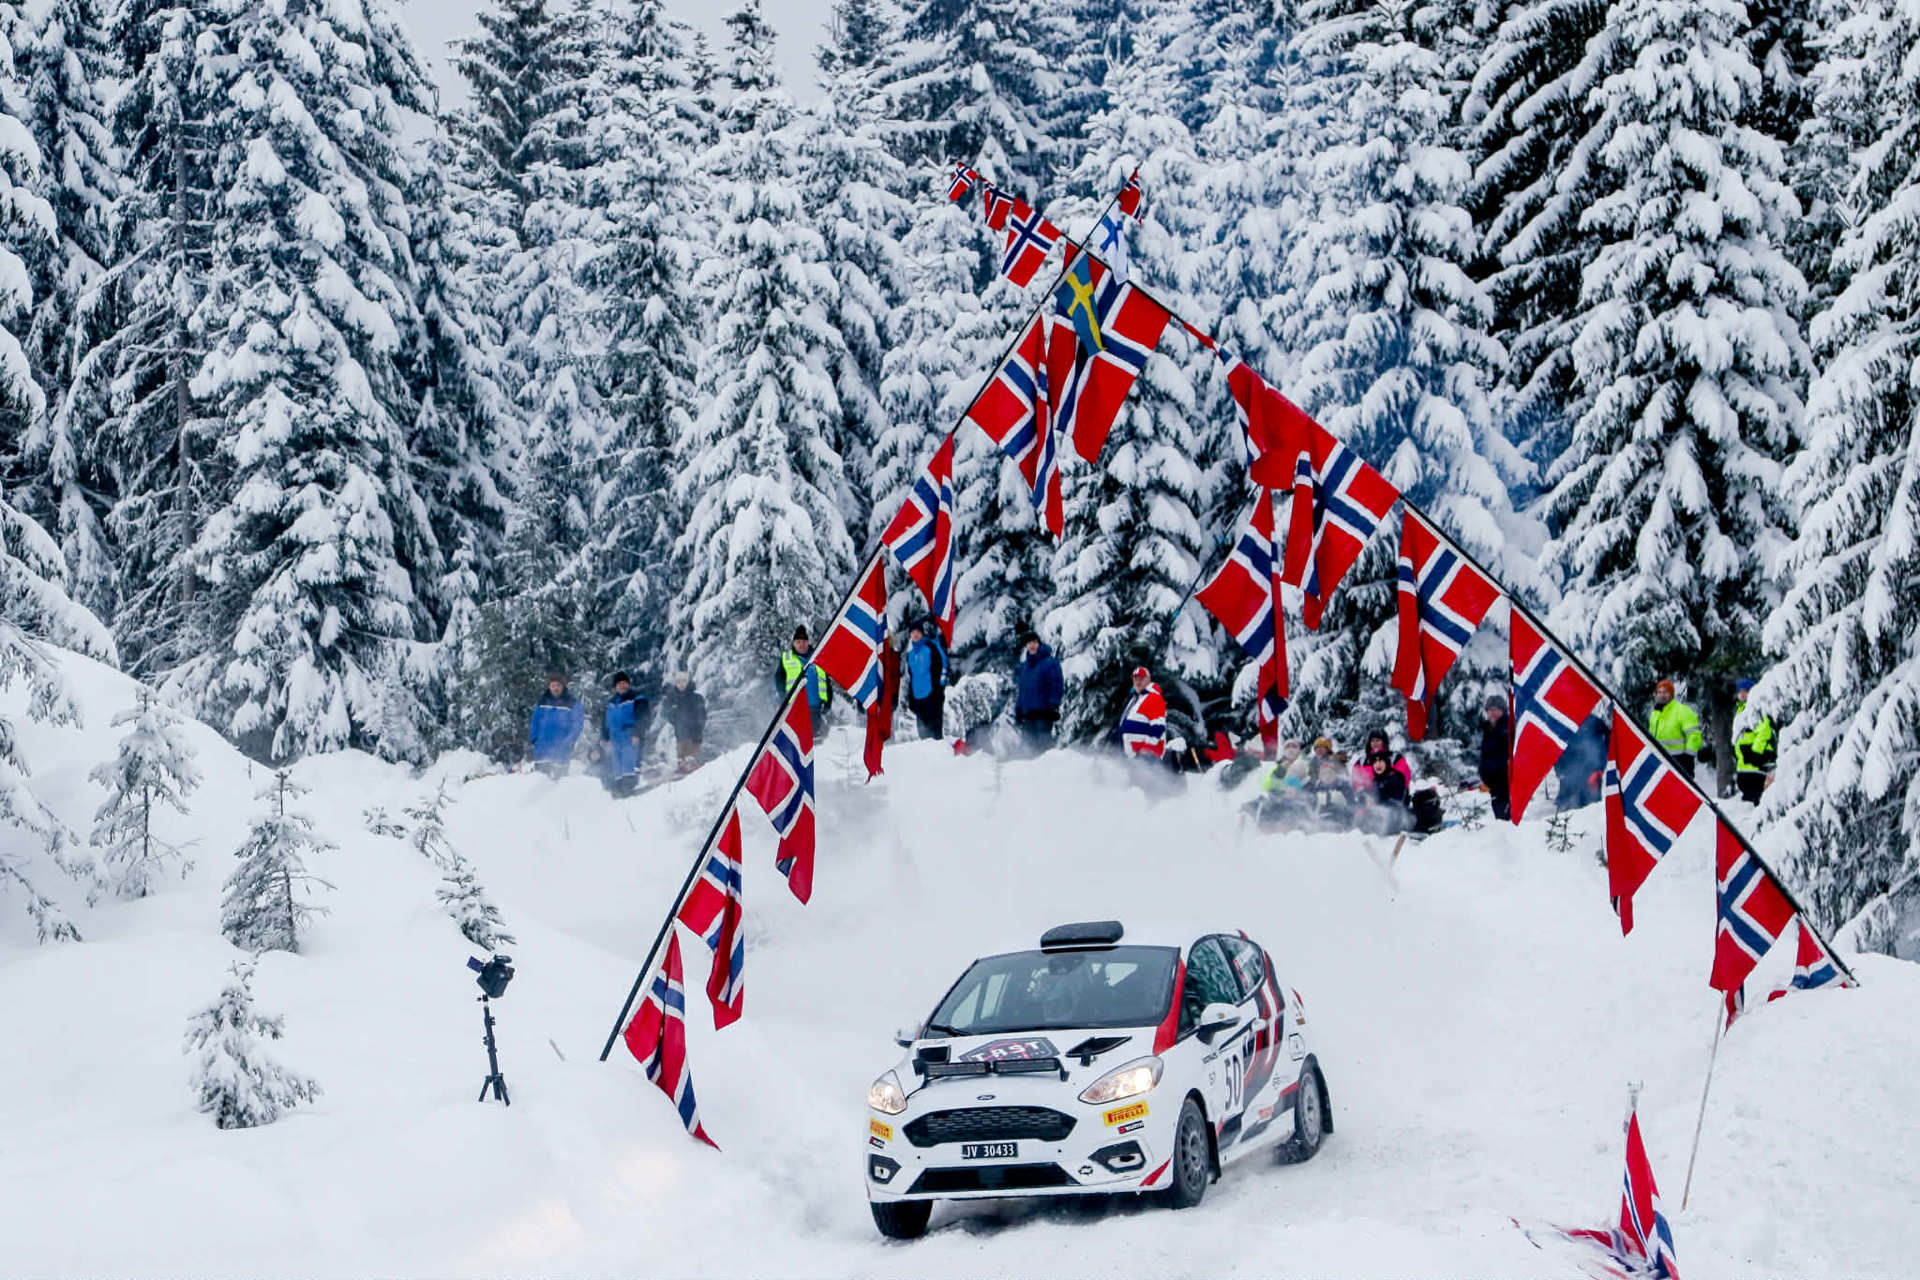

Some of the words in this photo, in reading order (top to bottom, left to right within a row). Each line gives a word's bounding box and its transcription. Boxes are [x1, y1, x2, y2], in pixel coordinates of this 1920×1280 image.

[1224, 1054, 1241, 1111] 50
[1107, 1103, 1144, 1123] PIRELLI
[966, 1145, 978, 1157] JV
[983, 1144, 1015, 1157] 30433
